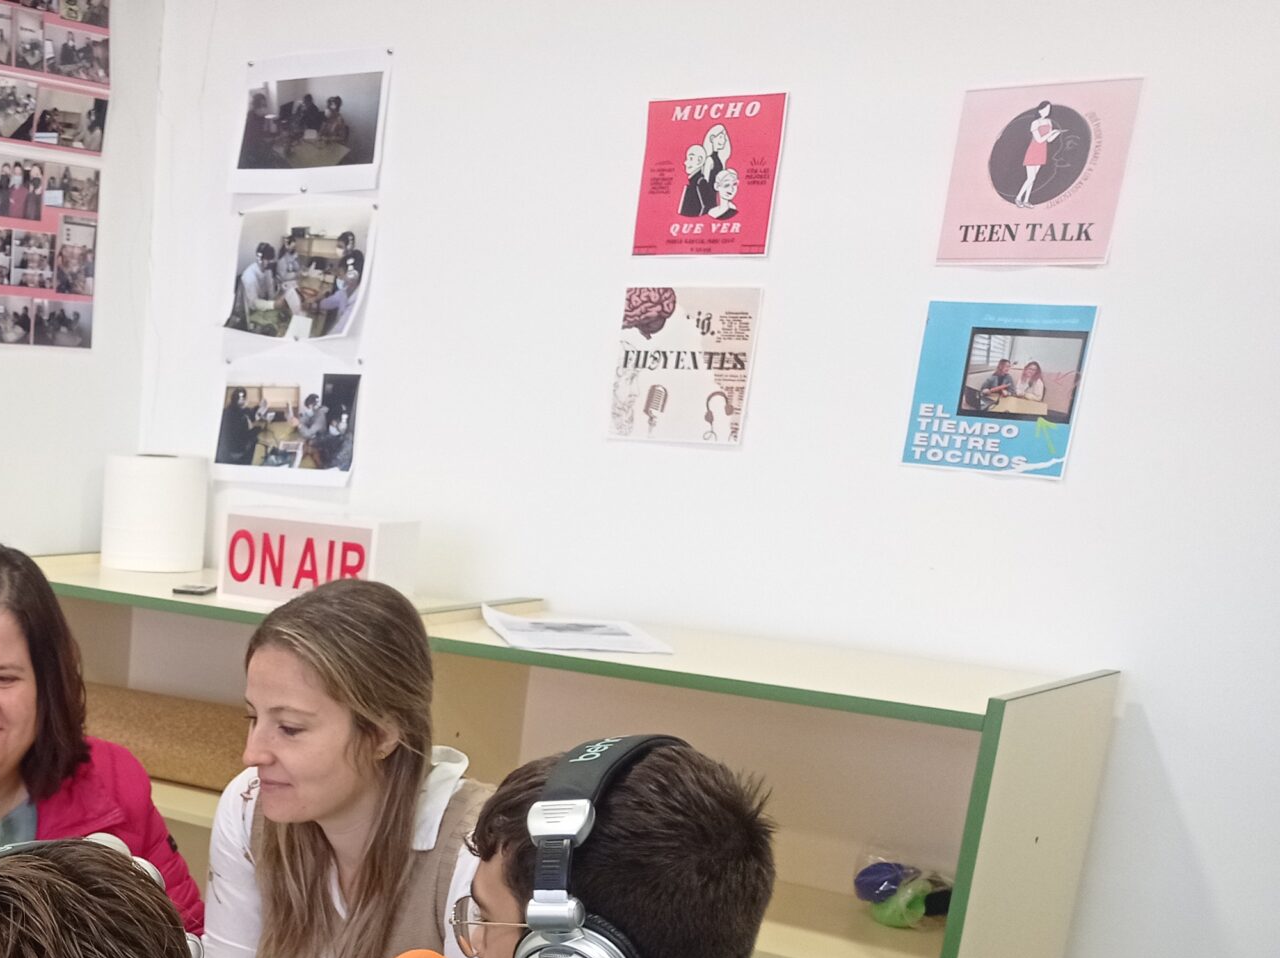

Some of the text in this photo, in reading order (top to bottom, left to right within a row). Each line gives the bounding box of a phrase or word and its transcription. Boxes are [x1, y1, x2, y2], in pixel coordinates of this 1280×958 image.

[671, 101, 761, 121] MUCHO
[669, 222, 742, 236] QUE VER
[959, 222, 1095, 243] TEEN TALK
[918, 402, 950, 418] EL
[917, 417, 1019, 439] TIEMPO
[913, 432, 1001, 453] ENTRE
[911, 446, 1028, 468] TOCINOS
[228, 529, 366, 589] ON AIR
